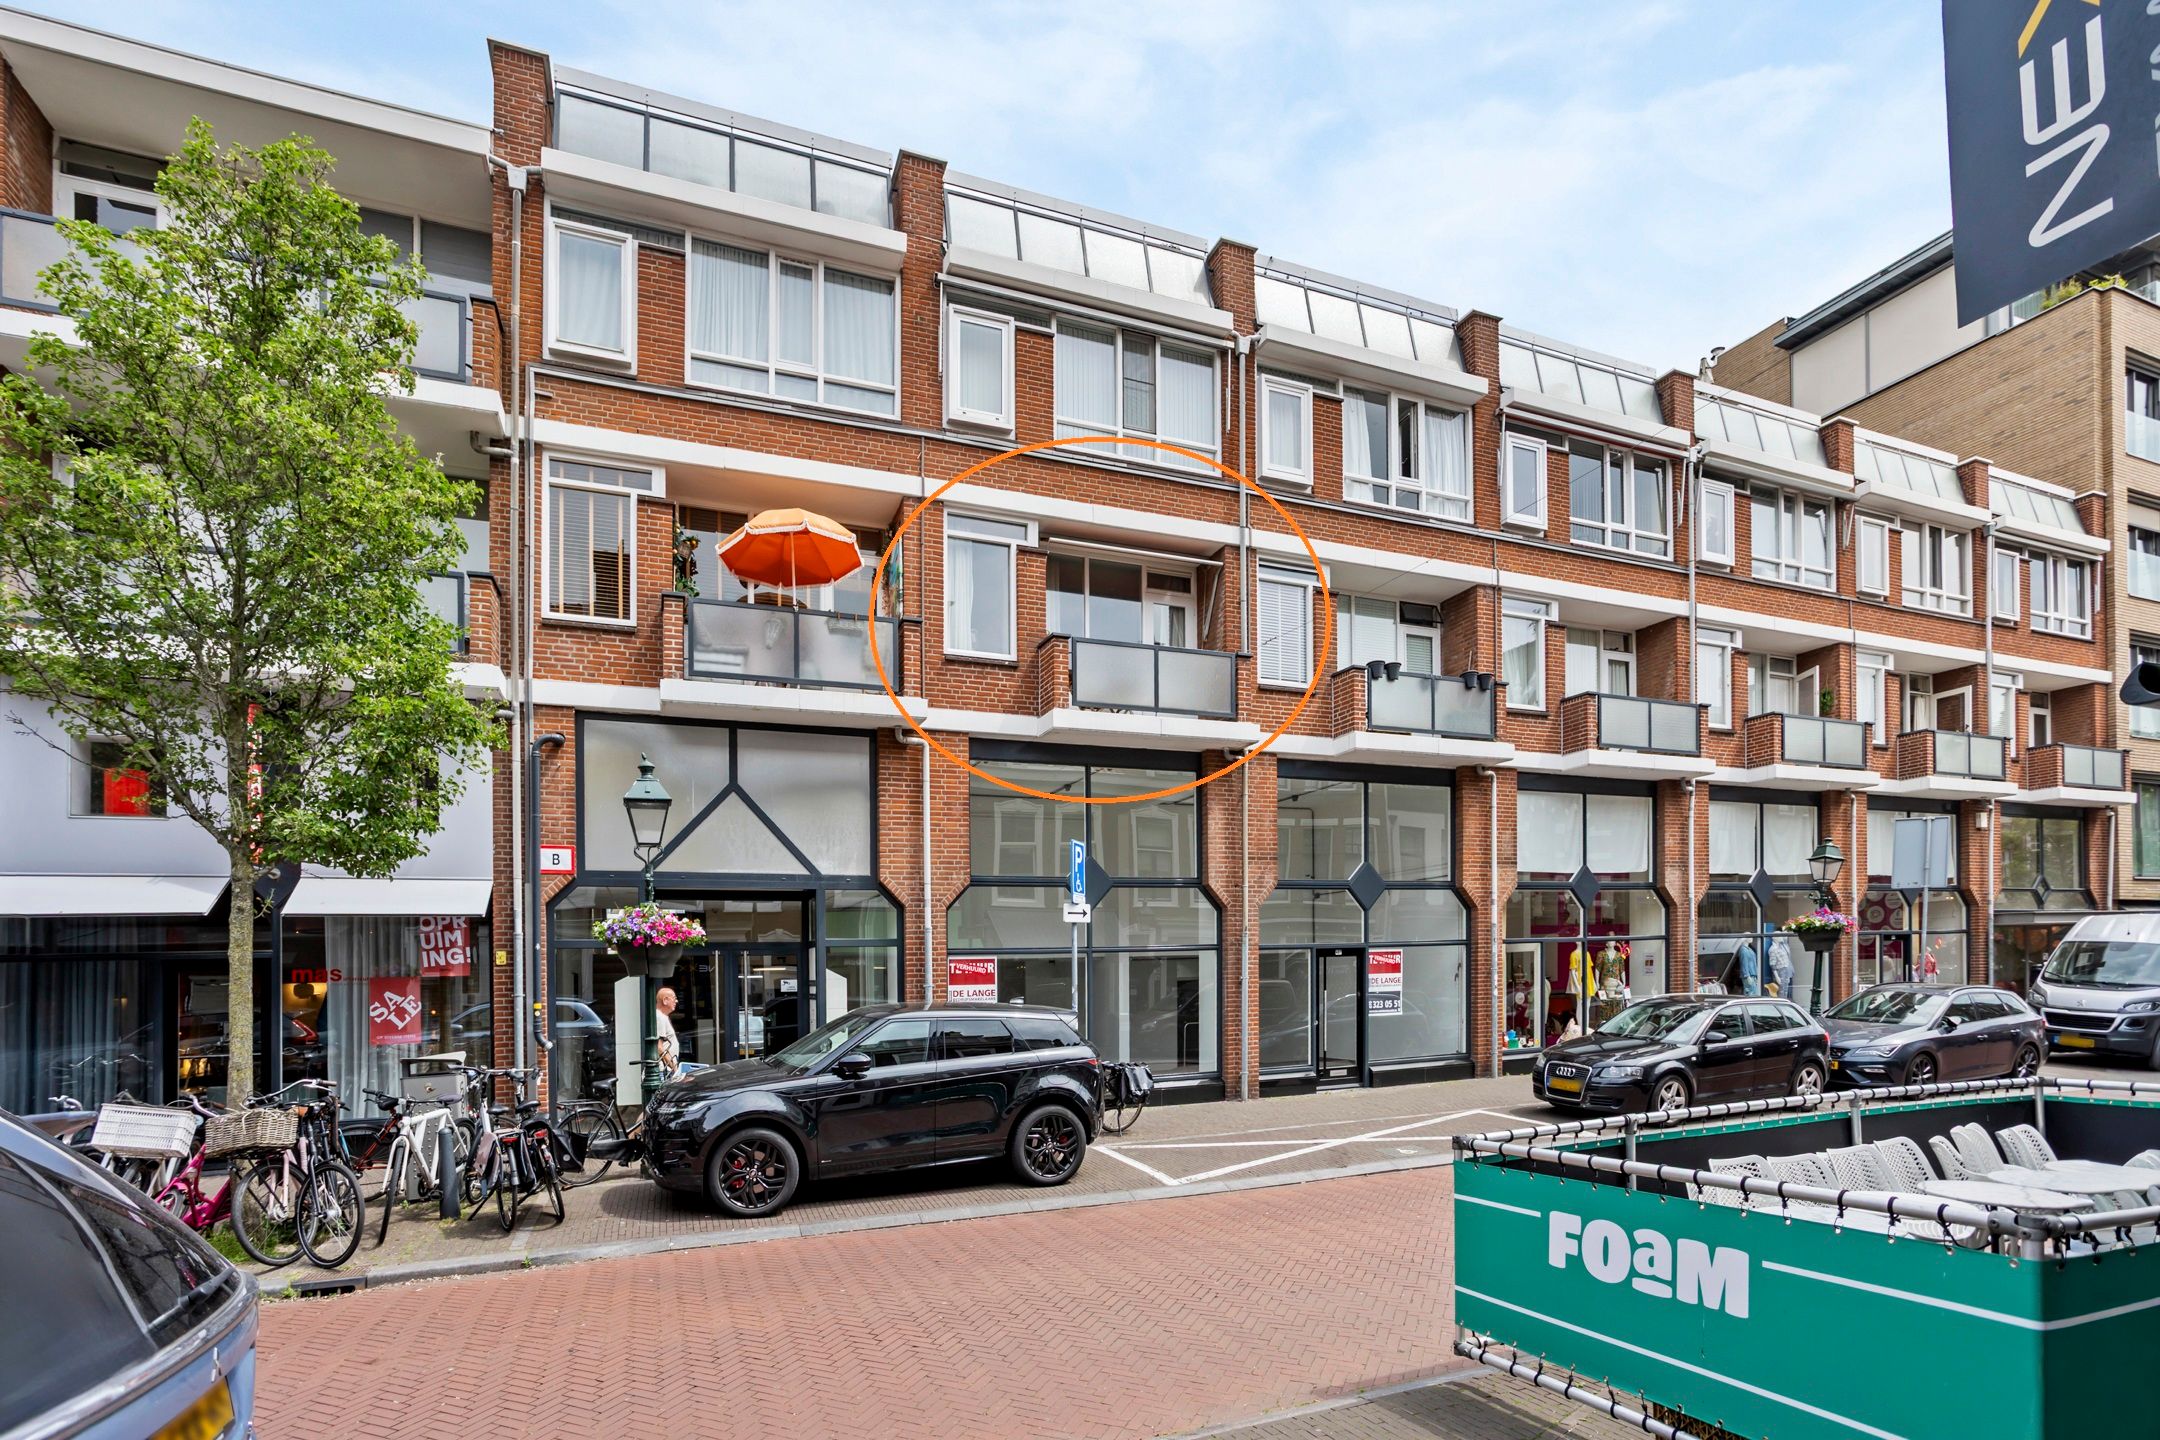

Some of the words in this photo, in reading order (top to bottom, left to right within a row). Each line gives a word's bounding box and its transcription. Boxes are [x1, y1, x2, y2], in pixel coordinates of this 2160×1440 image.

[552, 853, 561, 866] B
[1075, 846, 1083, 873] P
[420, 916, 467, 932] OPR
[419, 930, 463, 950] UIM
[422, 947, 471, 968] ING!
[291, 968, 342, 983] mas
